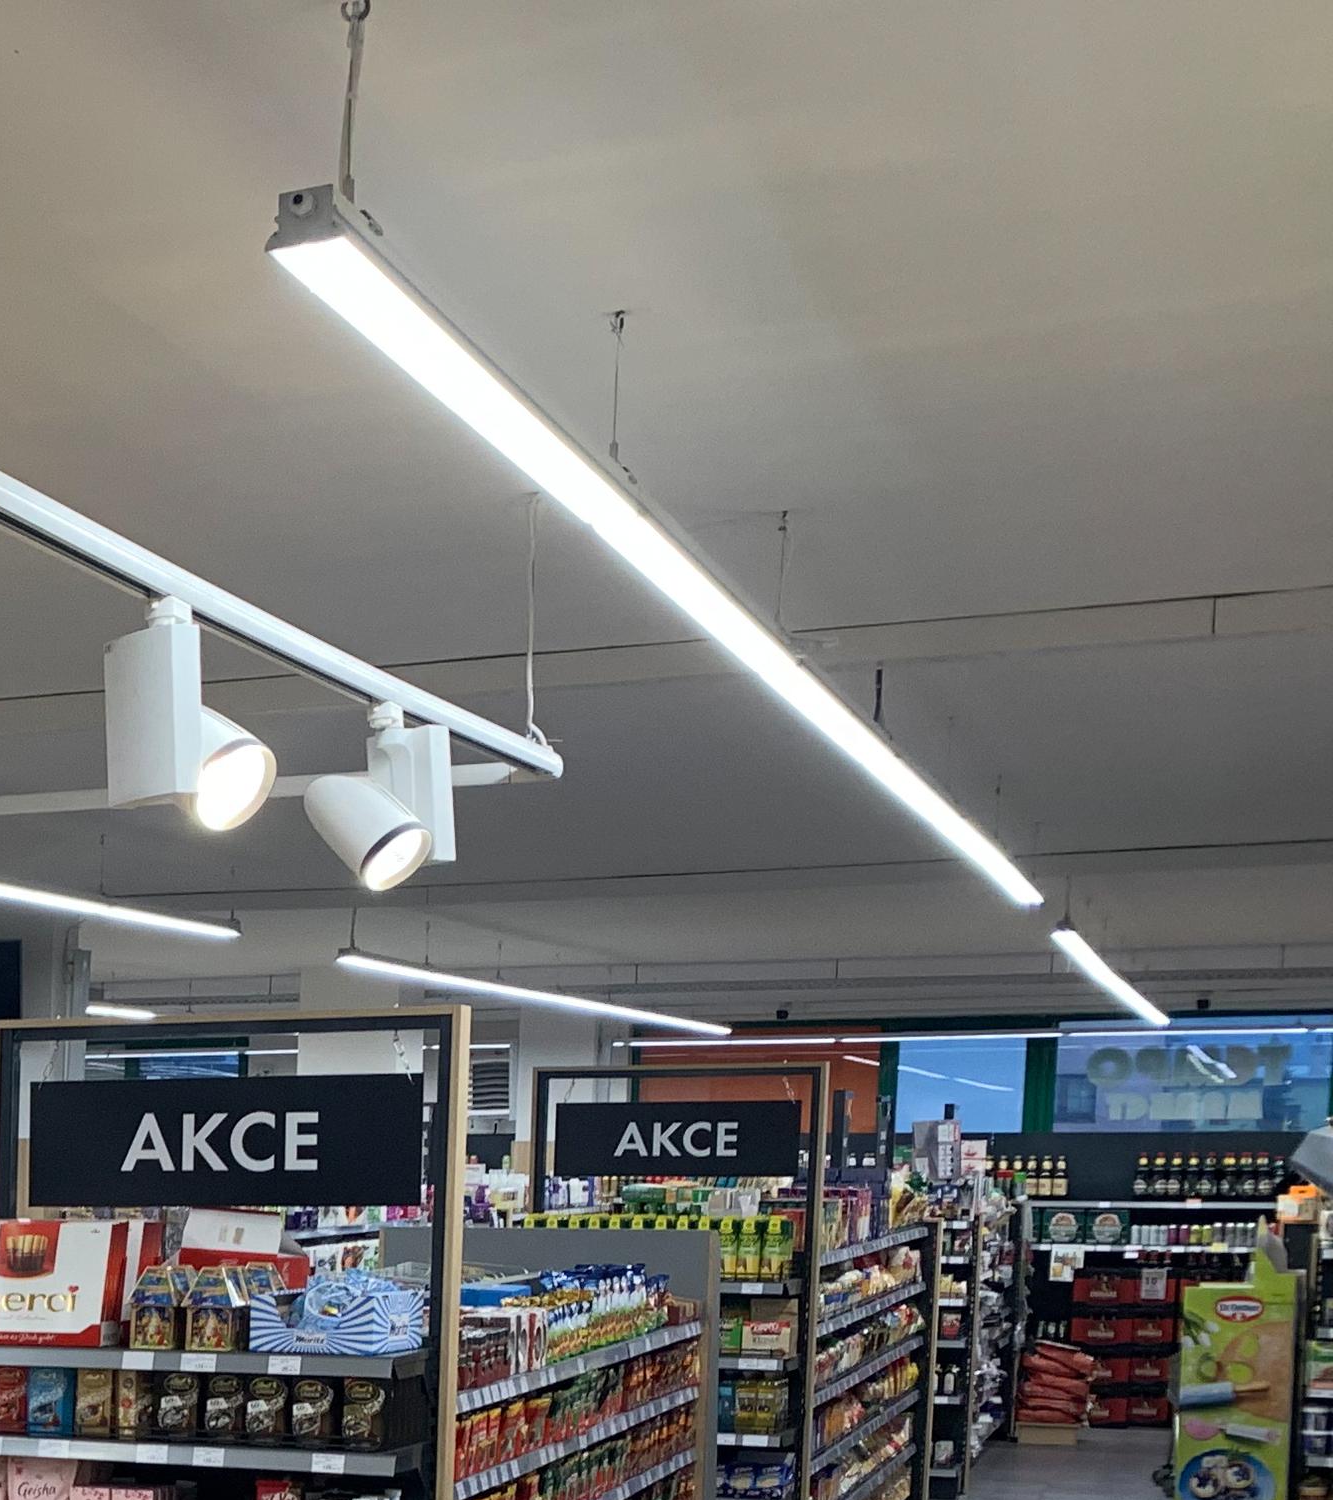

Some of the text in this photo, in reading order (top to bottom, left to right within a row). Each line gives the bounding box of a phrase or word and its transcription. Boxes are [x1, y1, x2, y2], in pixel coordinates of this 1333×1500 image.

[120, 1110, 320, 1173] AKCE
[613, 1121, 739, 1157] AKCE
[18, 1481, 57, 1499] Geisha
